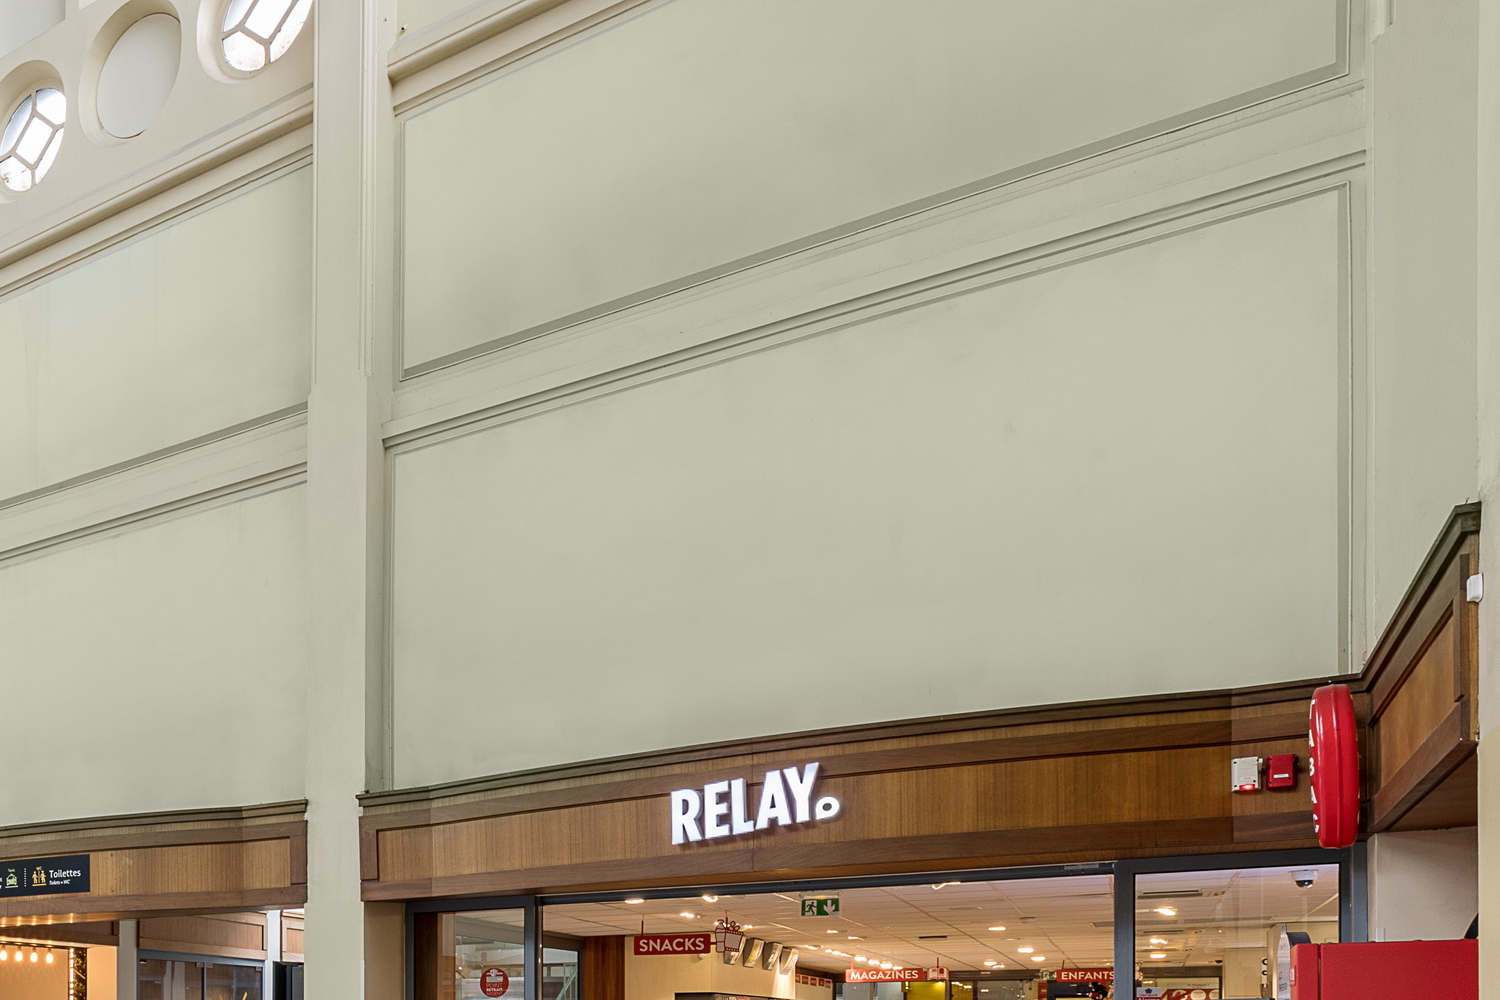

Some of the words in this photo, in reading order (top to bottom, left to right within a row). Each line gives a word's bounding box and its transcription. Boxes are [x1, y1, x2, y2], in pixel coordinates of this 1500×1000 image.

[670, 761, 820, 846] RELAY
[49, 870, 82, 878] Toilettes
[639, 938, 705, 952] SNACKS
[850, 970, 919, 980] MAGAZINES
[1061, 972, 1114, 980] ENFANTS
